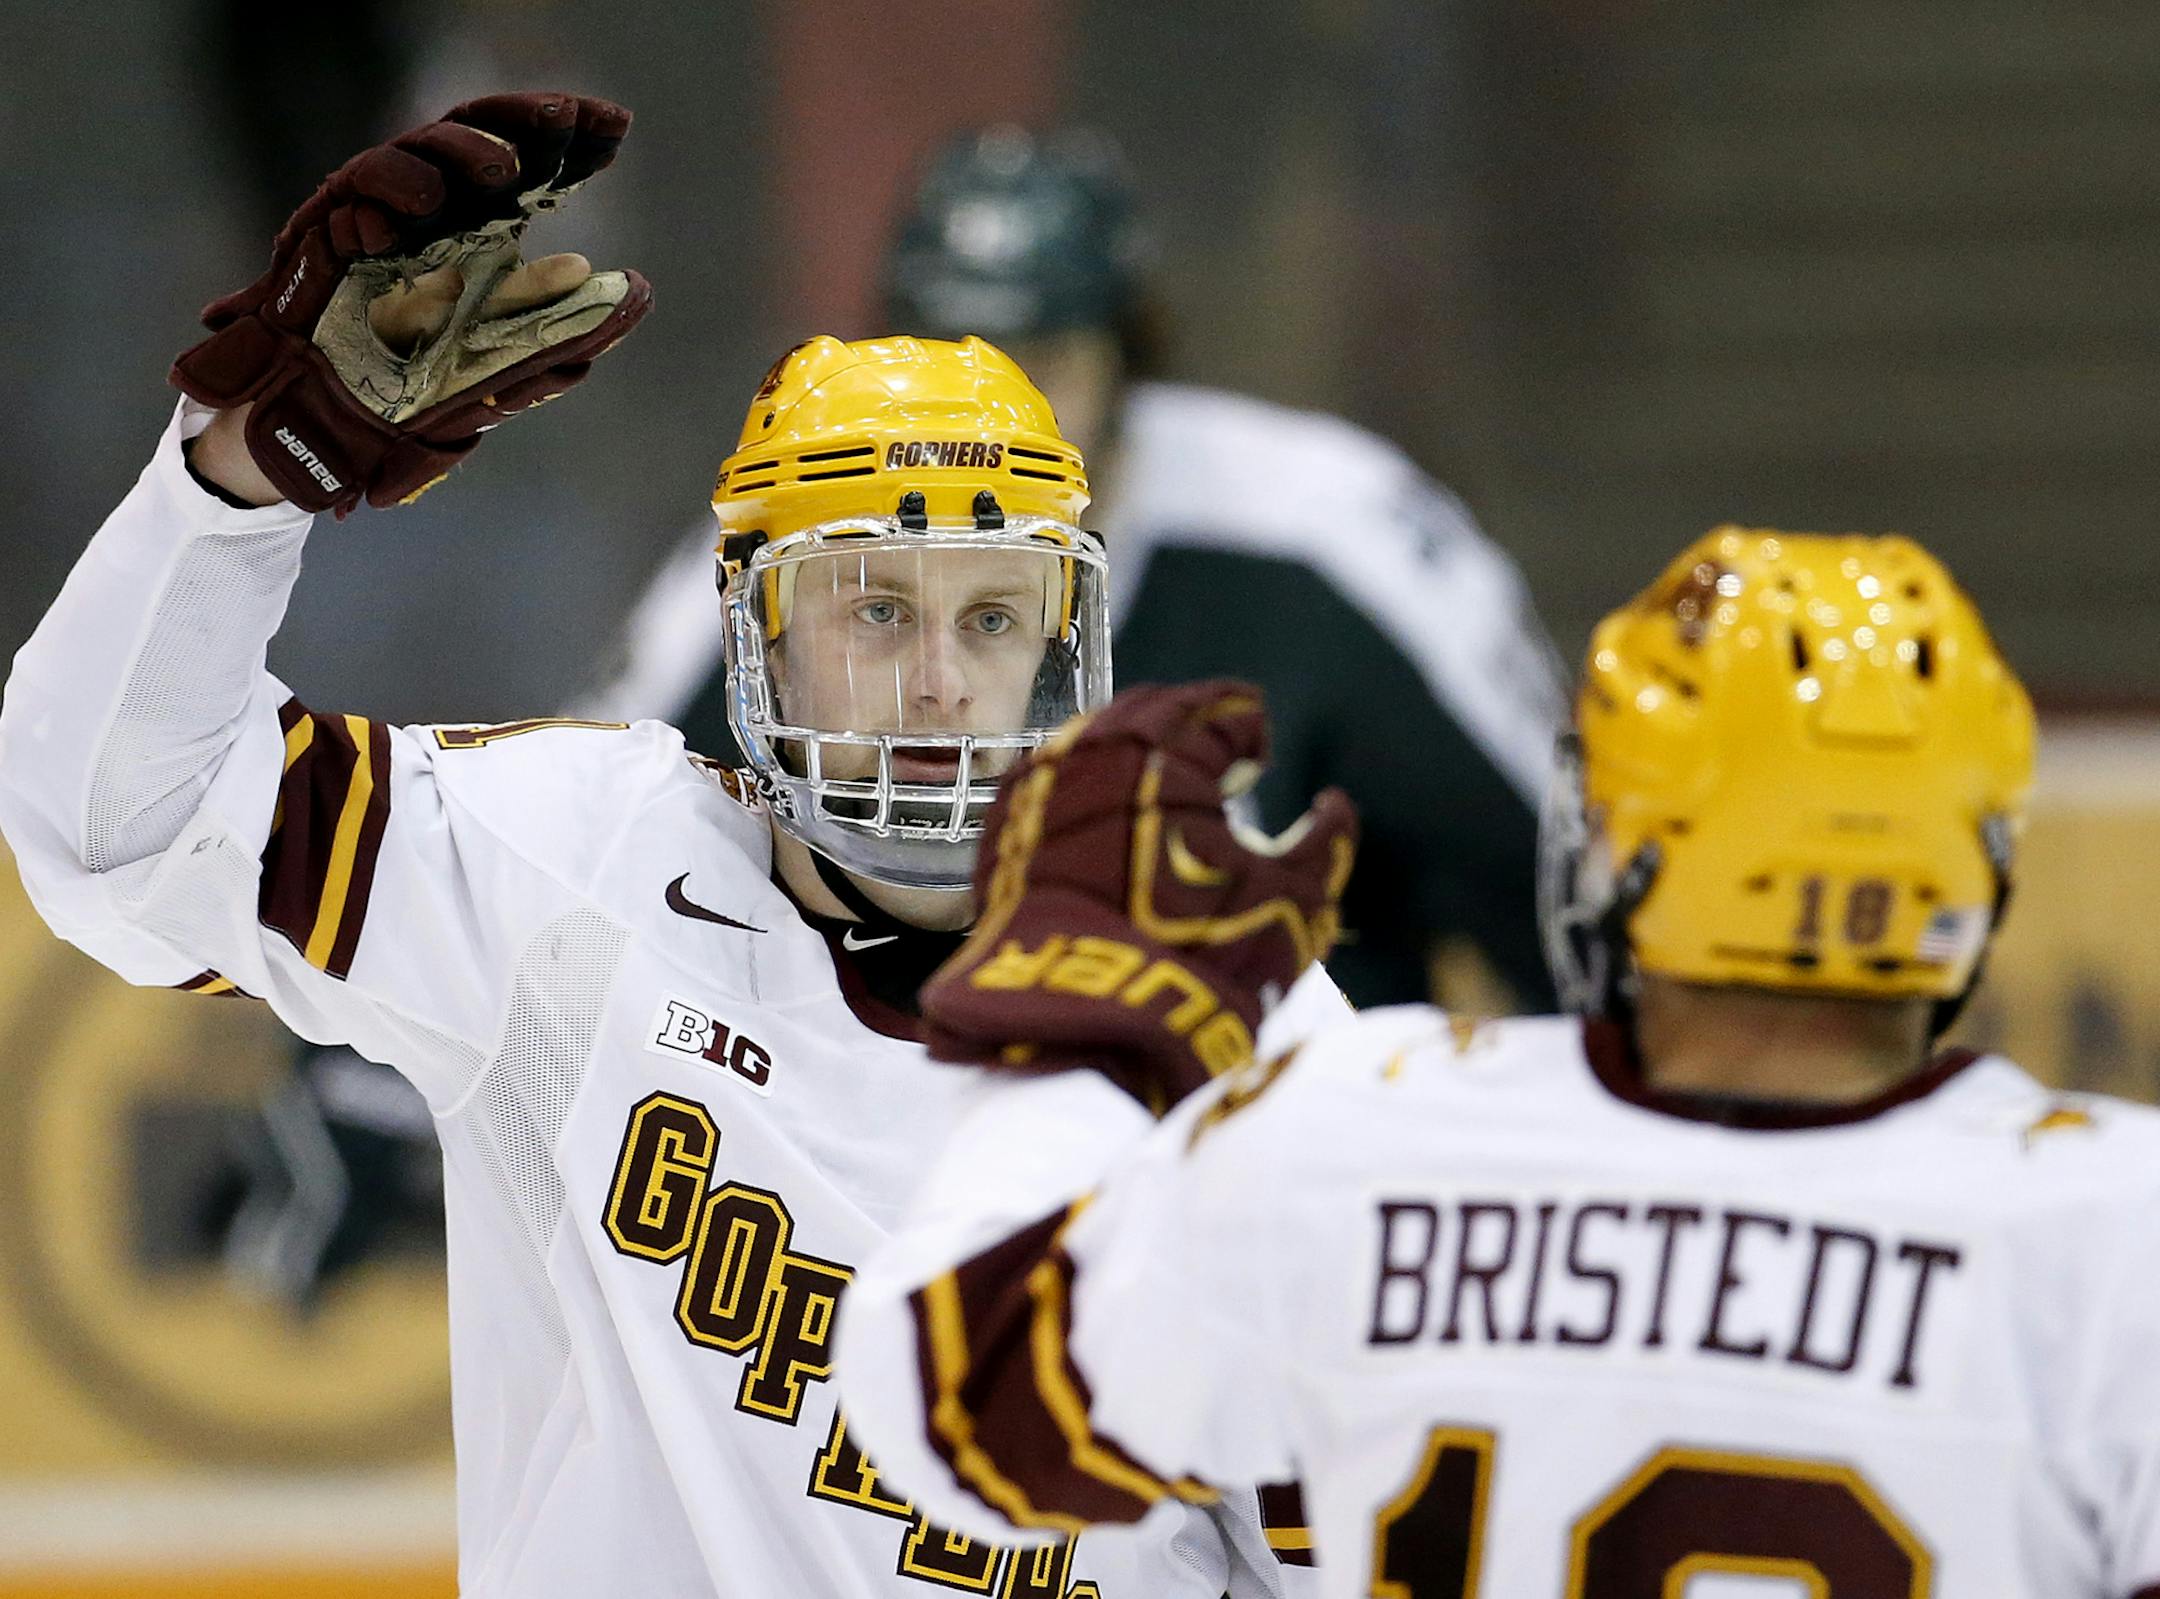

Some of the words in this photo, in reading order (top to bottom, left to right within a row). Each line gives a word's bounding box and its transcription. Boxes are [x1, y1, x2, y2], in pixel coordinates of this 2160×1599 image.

[274, 426, 343, 493] BAUER
[884, 441, 1004, 469] GOPHERS
[1367, 1200, 1962, 1389] BRISTEDT
